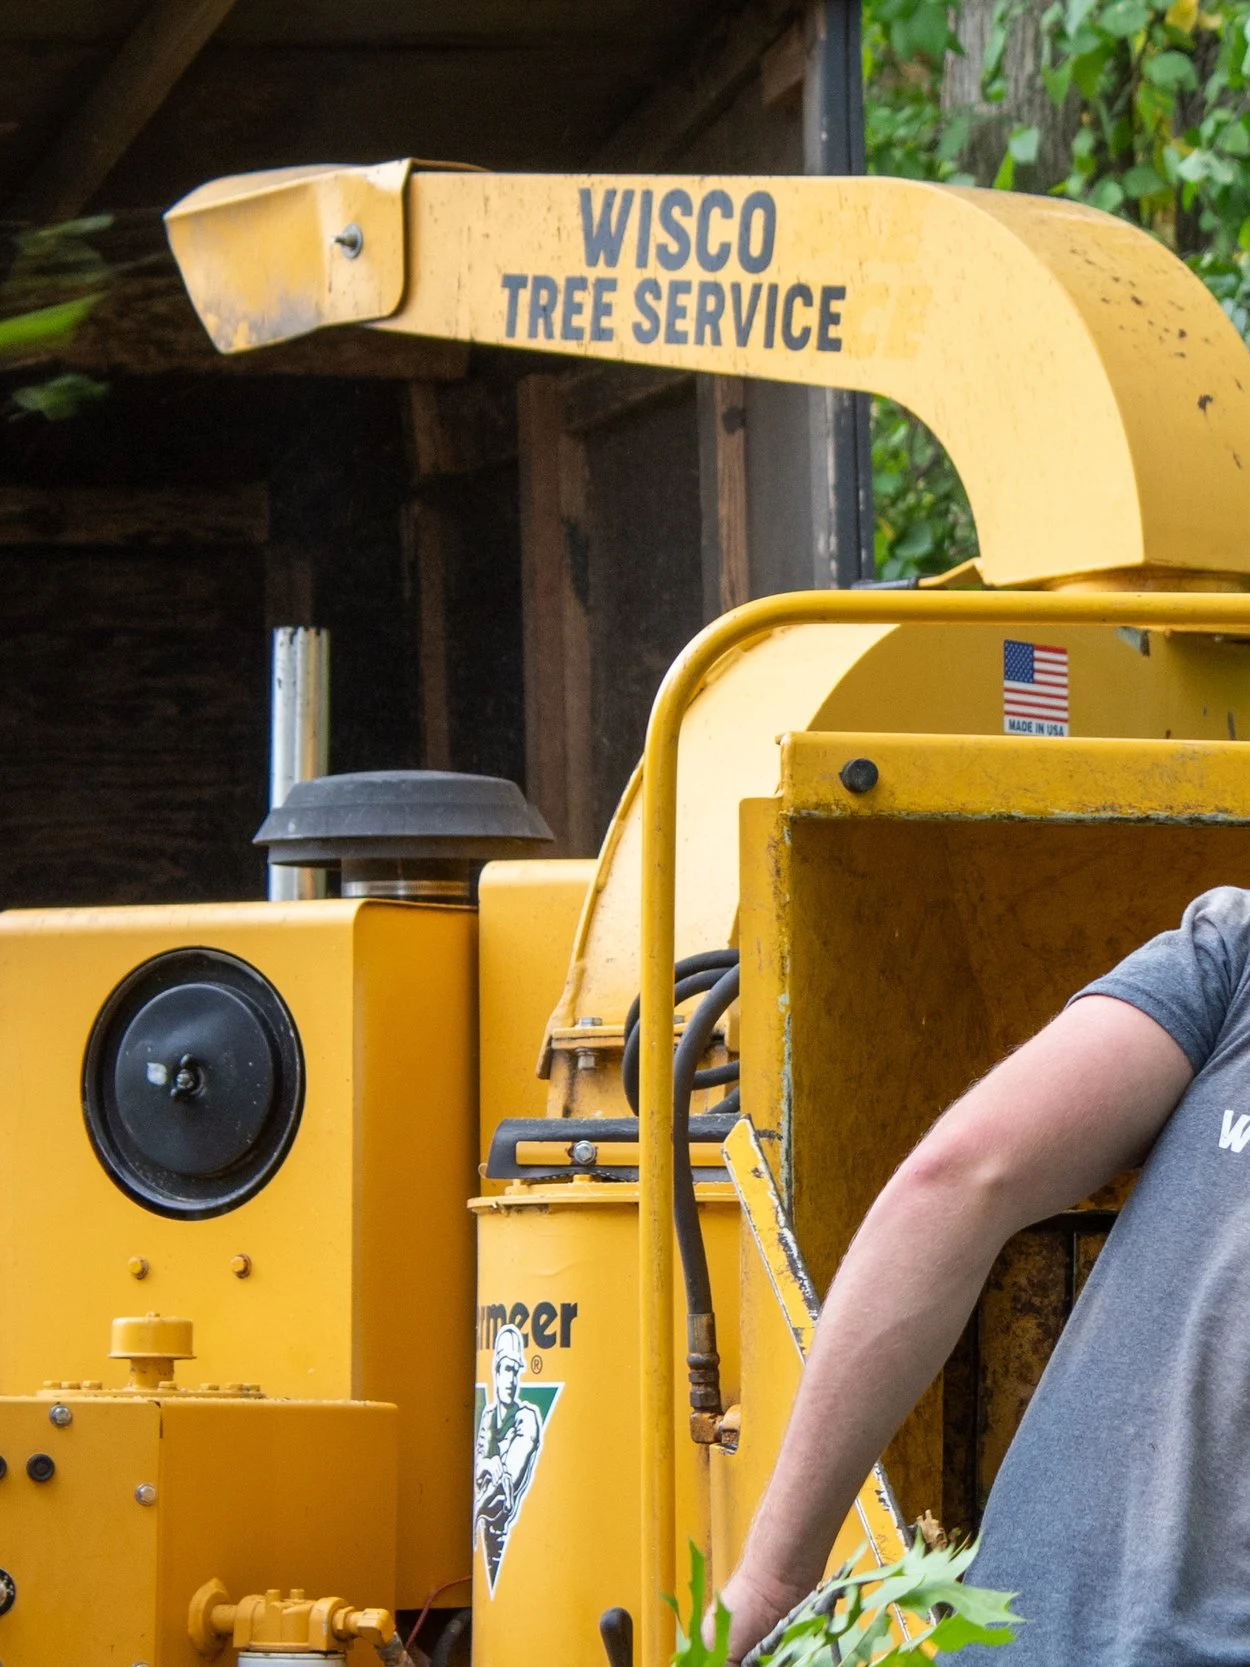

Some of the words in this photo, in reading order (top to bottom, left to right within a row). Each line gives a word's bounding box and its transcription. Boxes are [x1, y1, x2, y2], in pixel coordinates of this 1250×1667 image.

[578, 187, 777, 274] WISCO
[501, 273, 618, 342] TREE
[632, 276, 846, 352] SERVICE
[1008, 718, 1033, 733] MADE
[1035, 722, 1045, 734] IN
[1046, 724, 1065, 737] USA
[477, 1301, 578, 1351] rmeer
